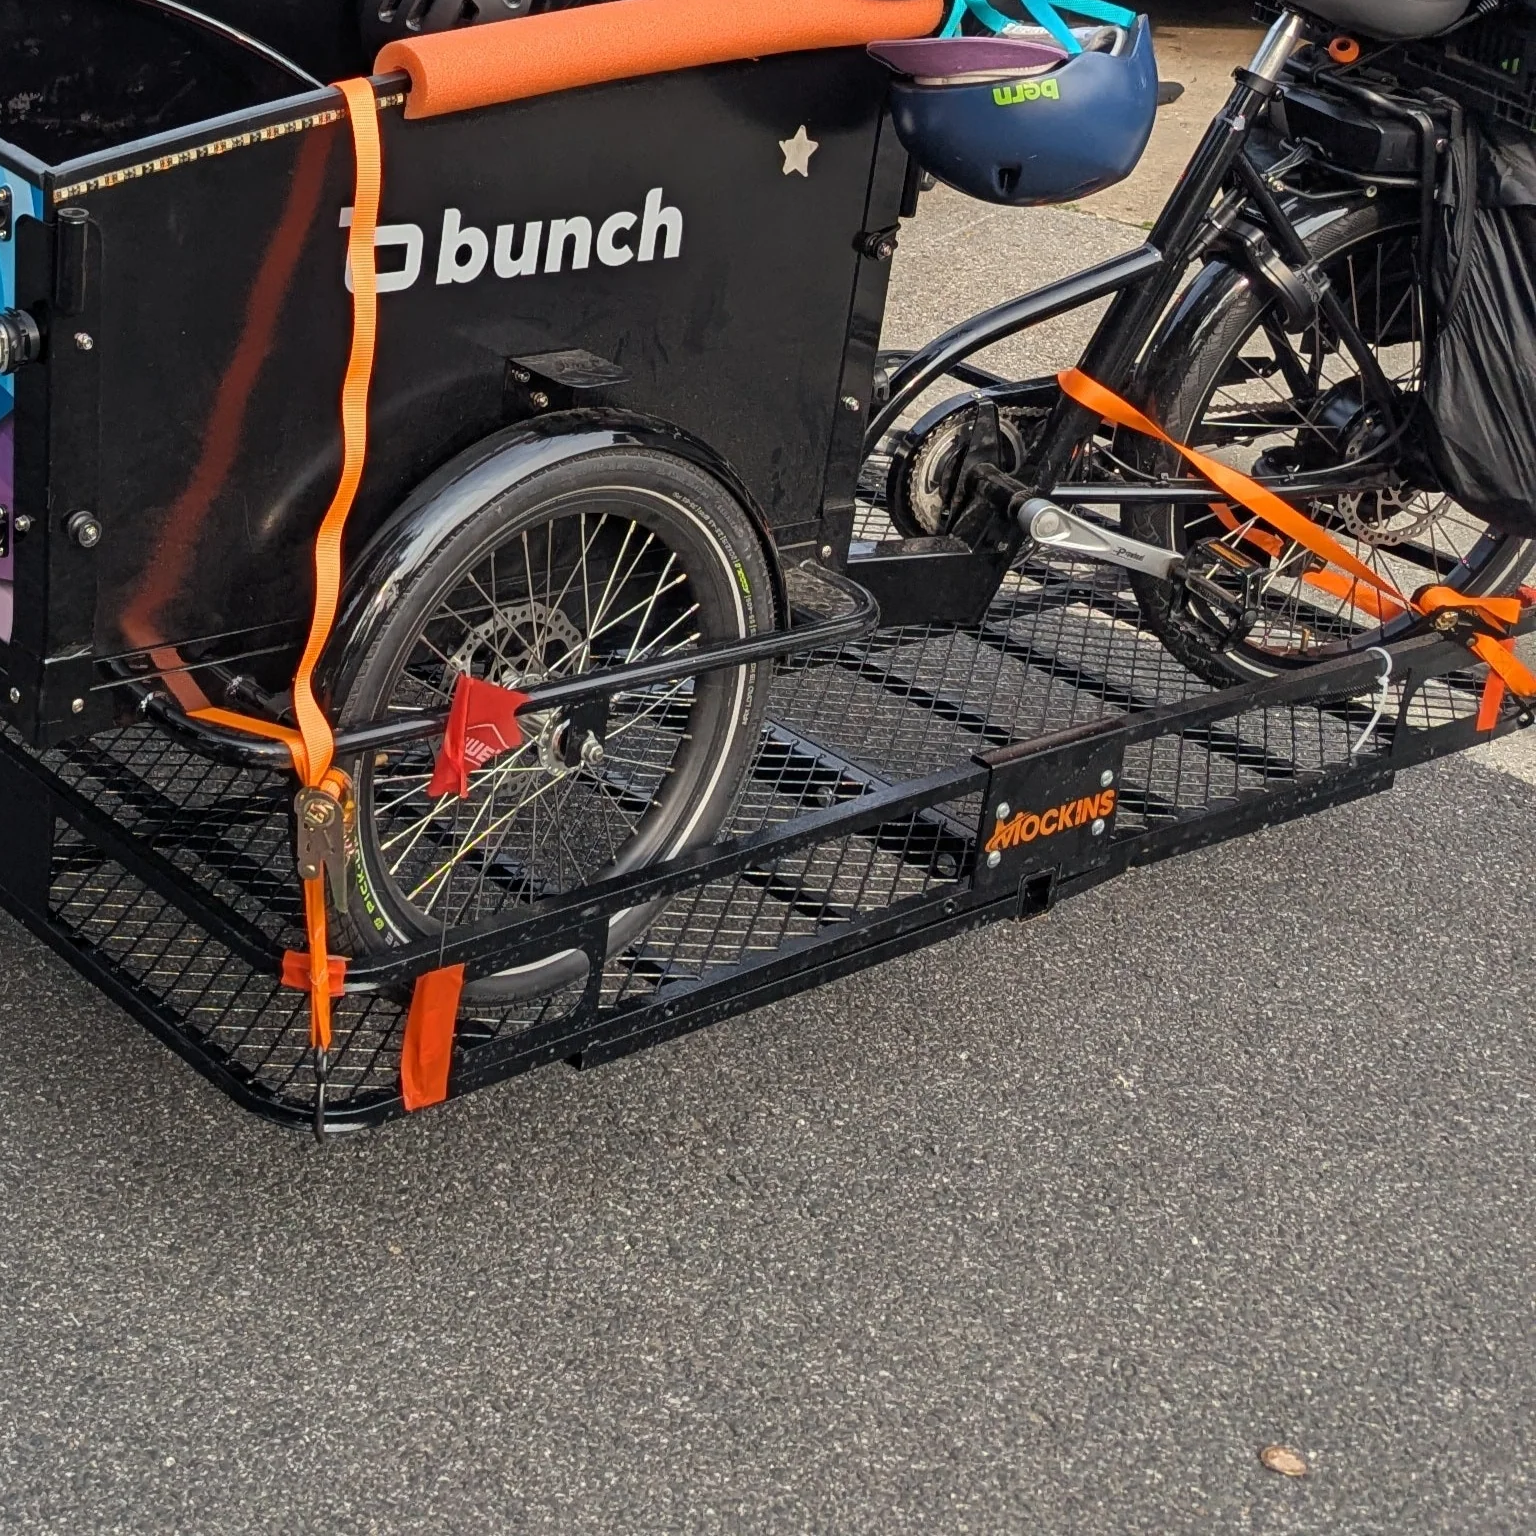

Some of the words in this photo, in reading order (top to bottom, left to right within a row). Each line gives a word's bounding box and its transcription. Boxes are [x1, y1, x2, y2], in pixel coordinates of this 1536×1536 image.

[992, 78, 1060, 106] bern
[435, 186, 684, 286] bunch
[984, 788, 1116, 853] MOCKINS
